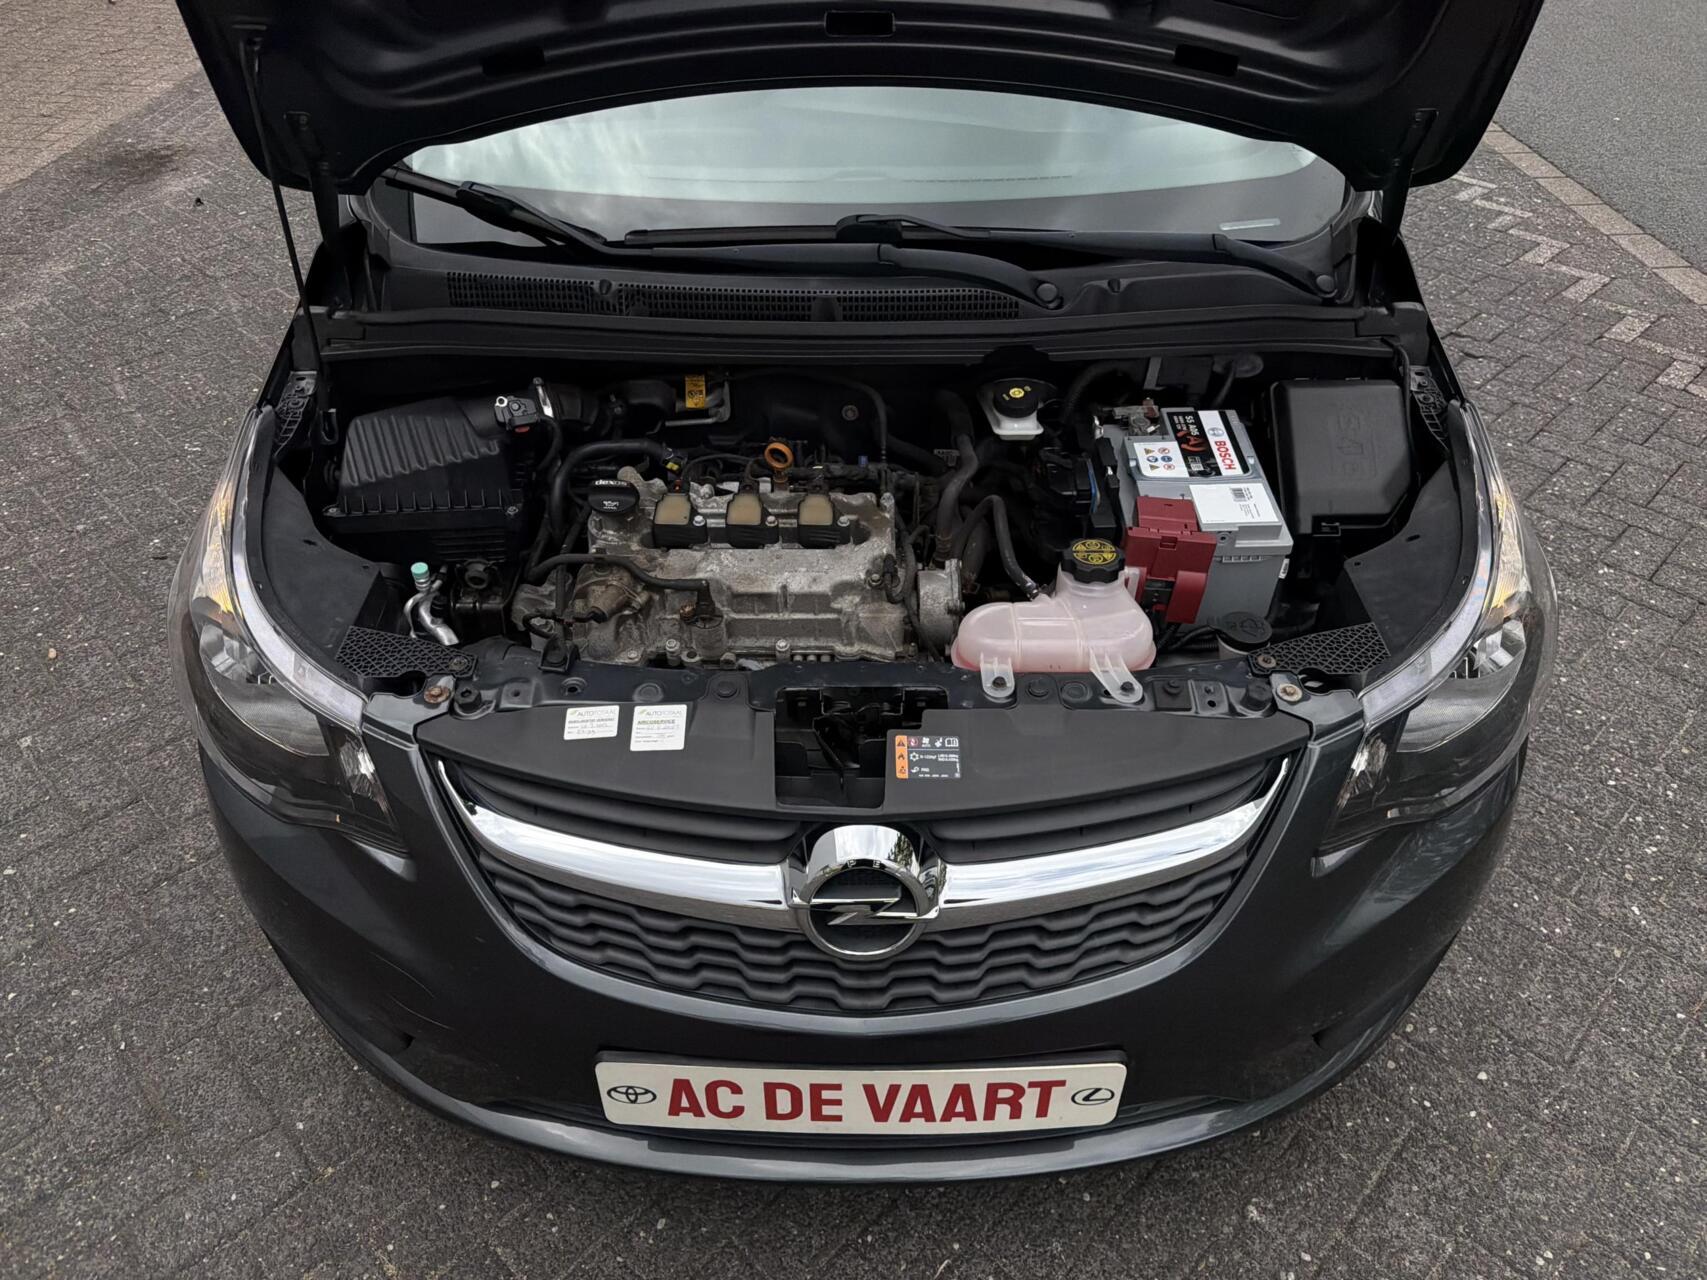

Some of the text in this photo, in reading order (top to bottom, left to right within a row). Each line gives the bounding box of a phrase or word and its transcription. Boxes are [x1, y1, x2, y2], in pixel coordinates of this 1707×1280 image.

[1214, 440, 1237, 470] BOSCH
[667, 1078, 1067, 1123] AC DE VAART
